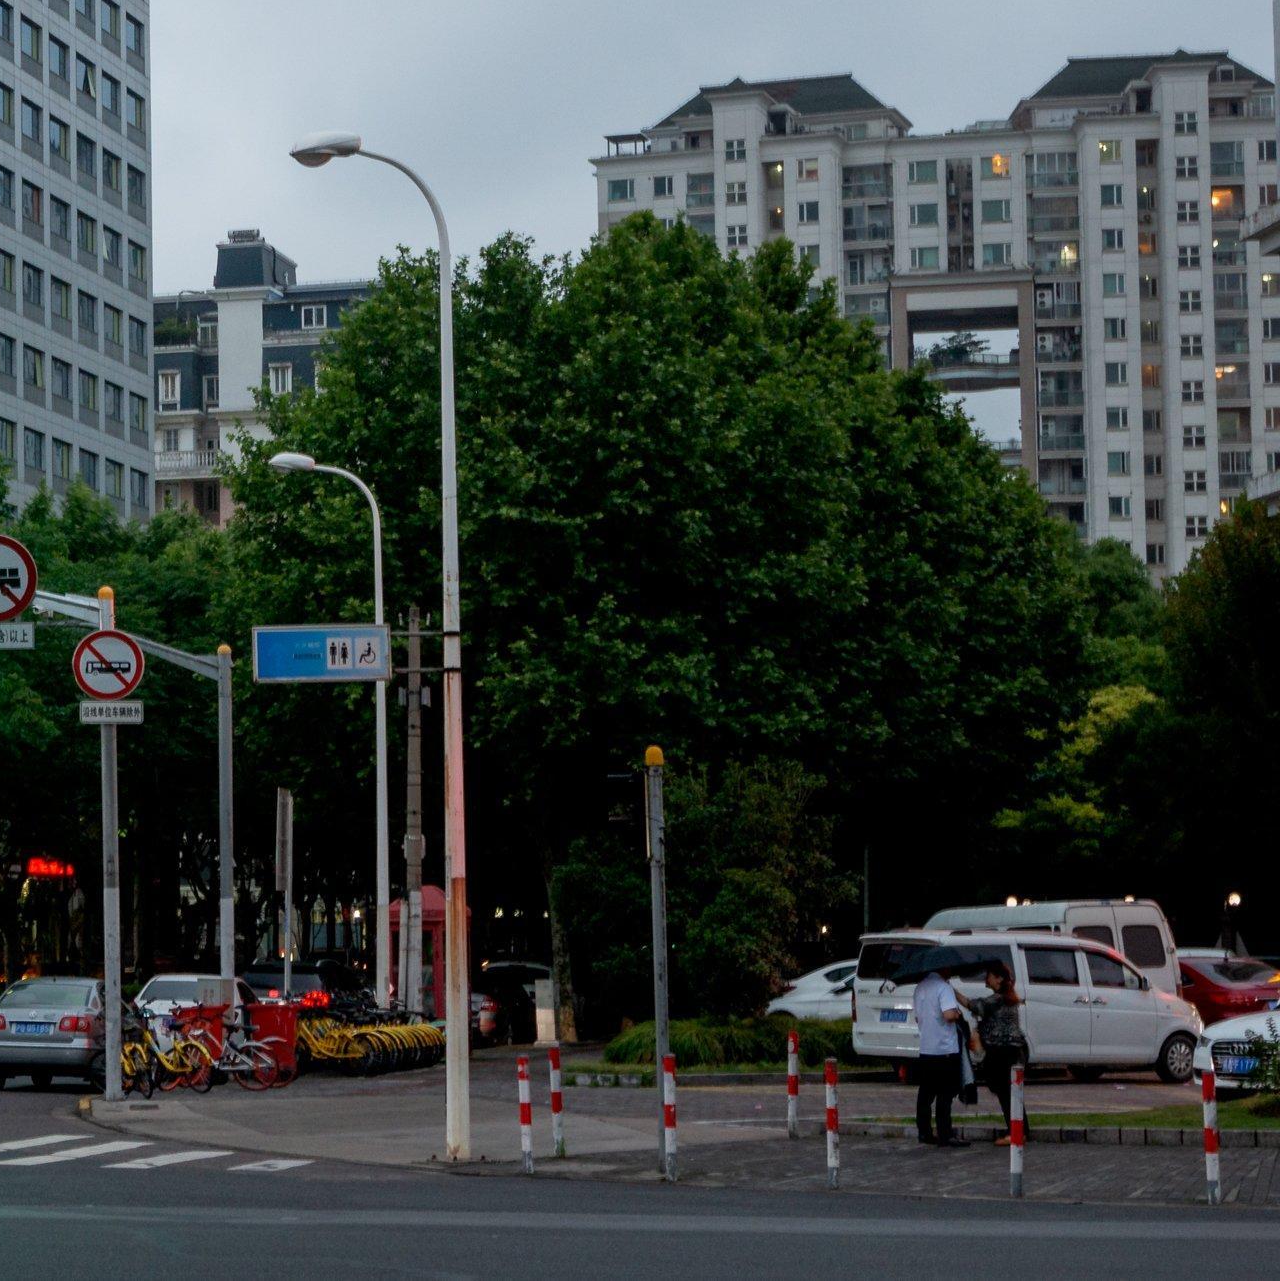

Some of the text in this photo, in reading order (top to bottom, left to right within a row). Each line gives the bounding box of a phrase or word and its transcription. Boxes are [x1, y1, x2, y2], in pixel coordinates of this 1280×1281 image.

[82, 704, 141, 718] 沿线单位车辆除外
